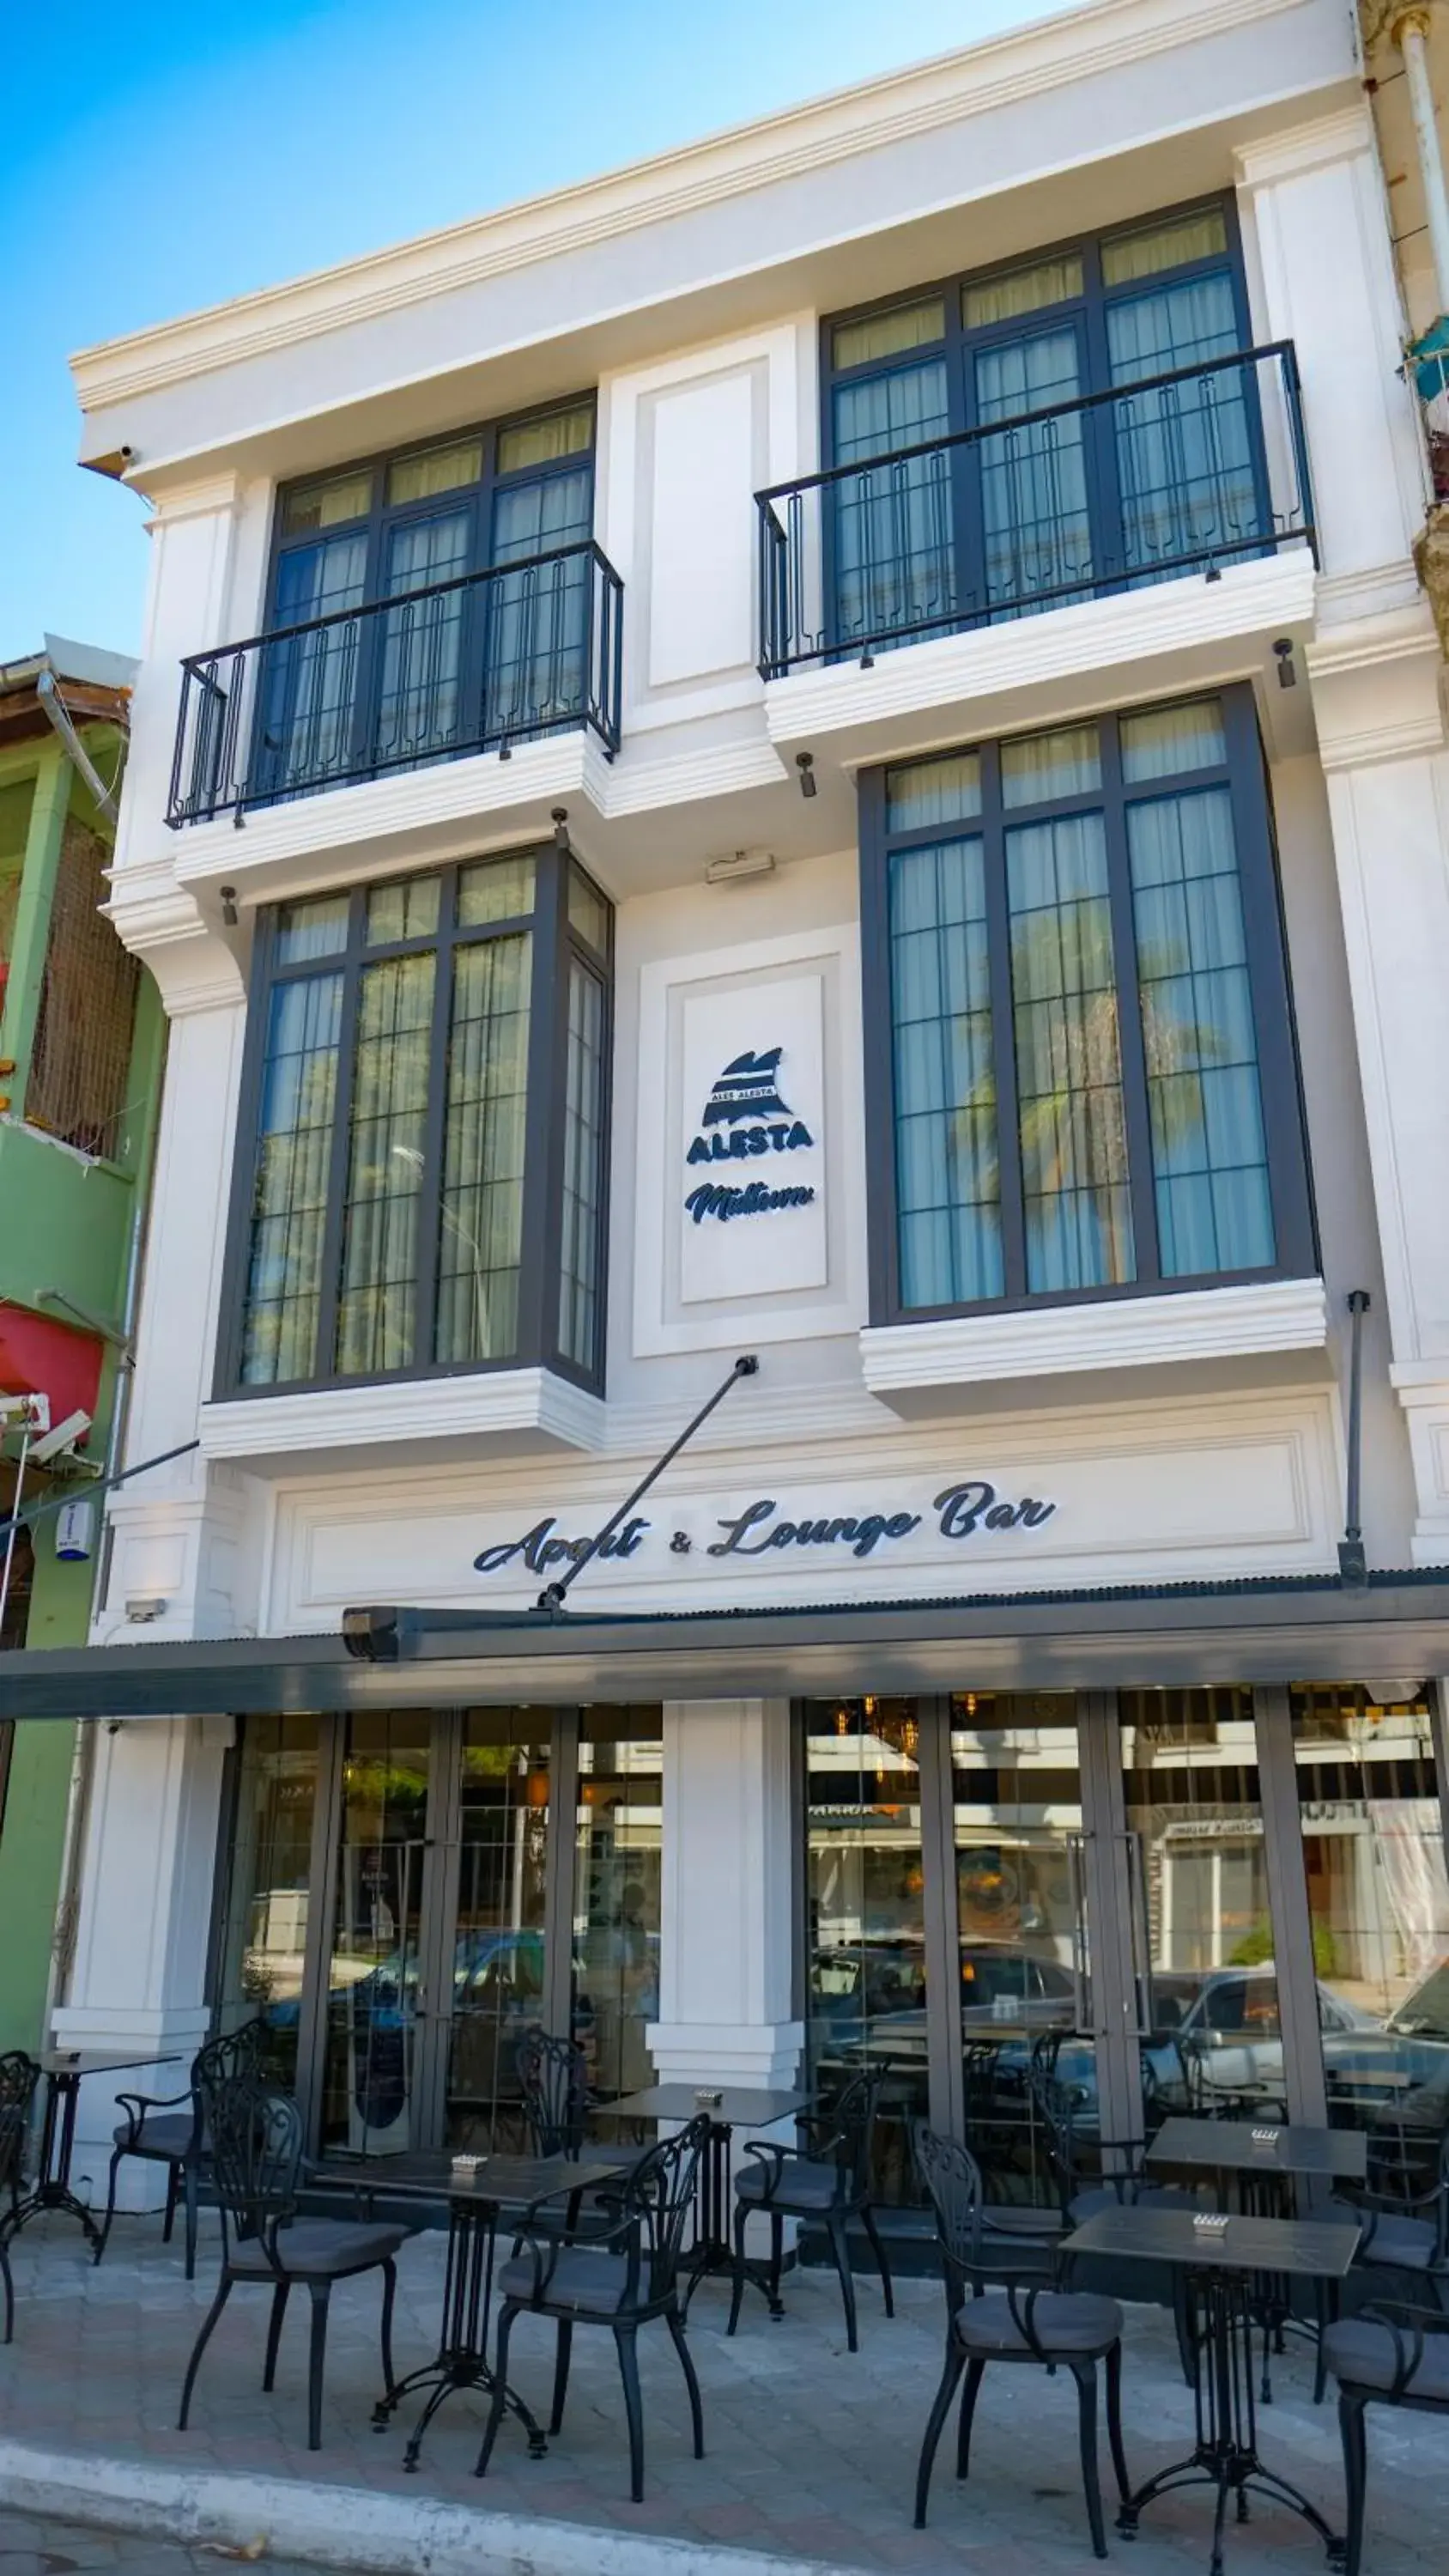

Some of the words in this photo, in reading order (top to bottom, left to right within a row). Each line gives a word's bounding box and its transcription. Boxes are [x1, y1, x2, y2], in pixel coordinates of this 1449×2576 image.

[686, 1121, 815, 1164] ALESTA
[684, 1182, 815, 1224] Midtown
[669, 1531, 693, 1553] &
[706, 1499, 923, 1558] Lounge
[933, 1481, 1057, 1540] Bar
